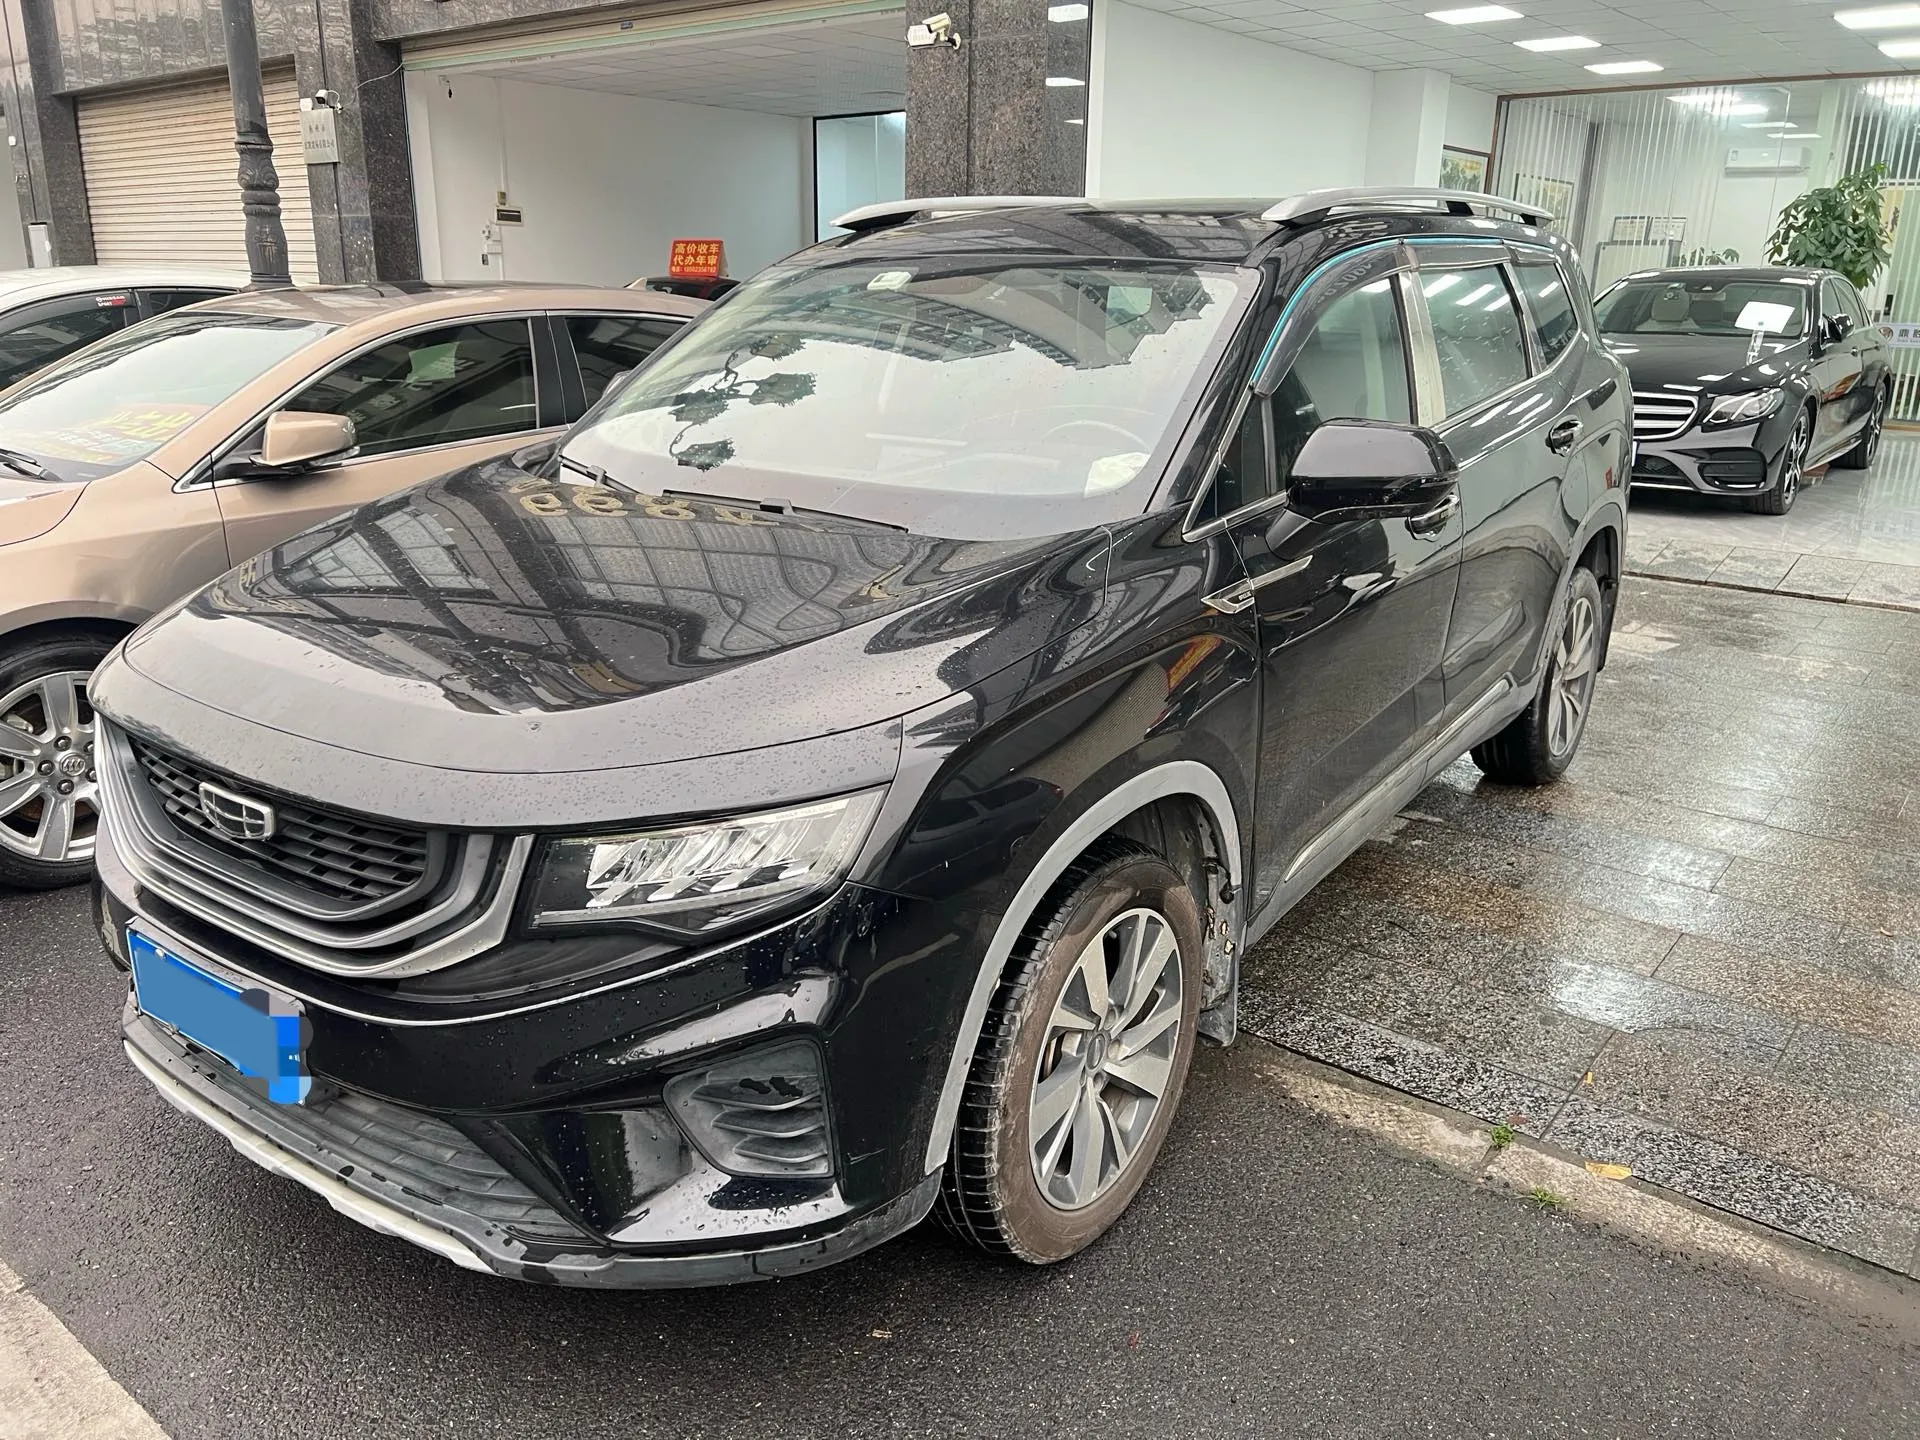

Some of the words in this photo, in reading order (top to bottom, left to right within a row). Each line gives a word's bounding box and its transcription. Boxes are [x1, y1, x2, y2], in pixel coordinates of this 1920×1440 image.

[675, 243, 719, 254] 高价收车
[673, 255, 718, 266] 代办年审
